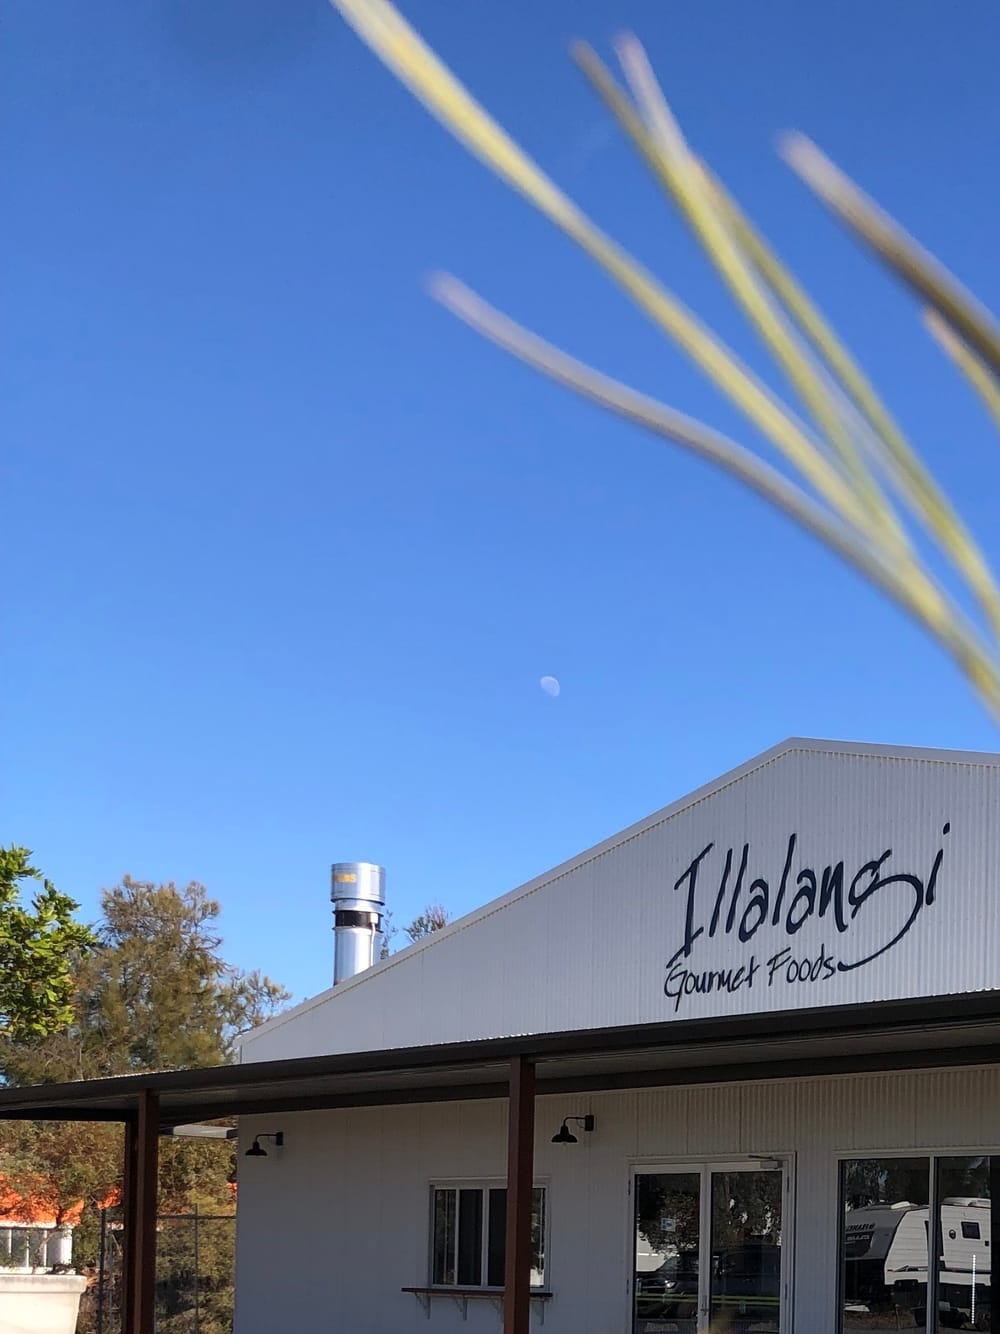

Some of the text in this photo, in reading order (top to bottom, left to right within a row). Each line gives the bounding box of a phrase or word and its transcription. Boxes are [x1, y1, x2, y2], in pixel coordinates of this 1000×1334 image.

[666, 822, 950, 972] Illalangi
[664, 944, 836, 1012] Gourmet Foods
